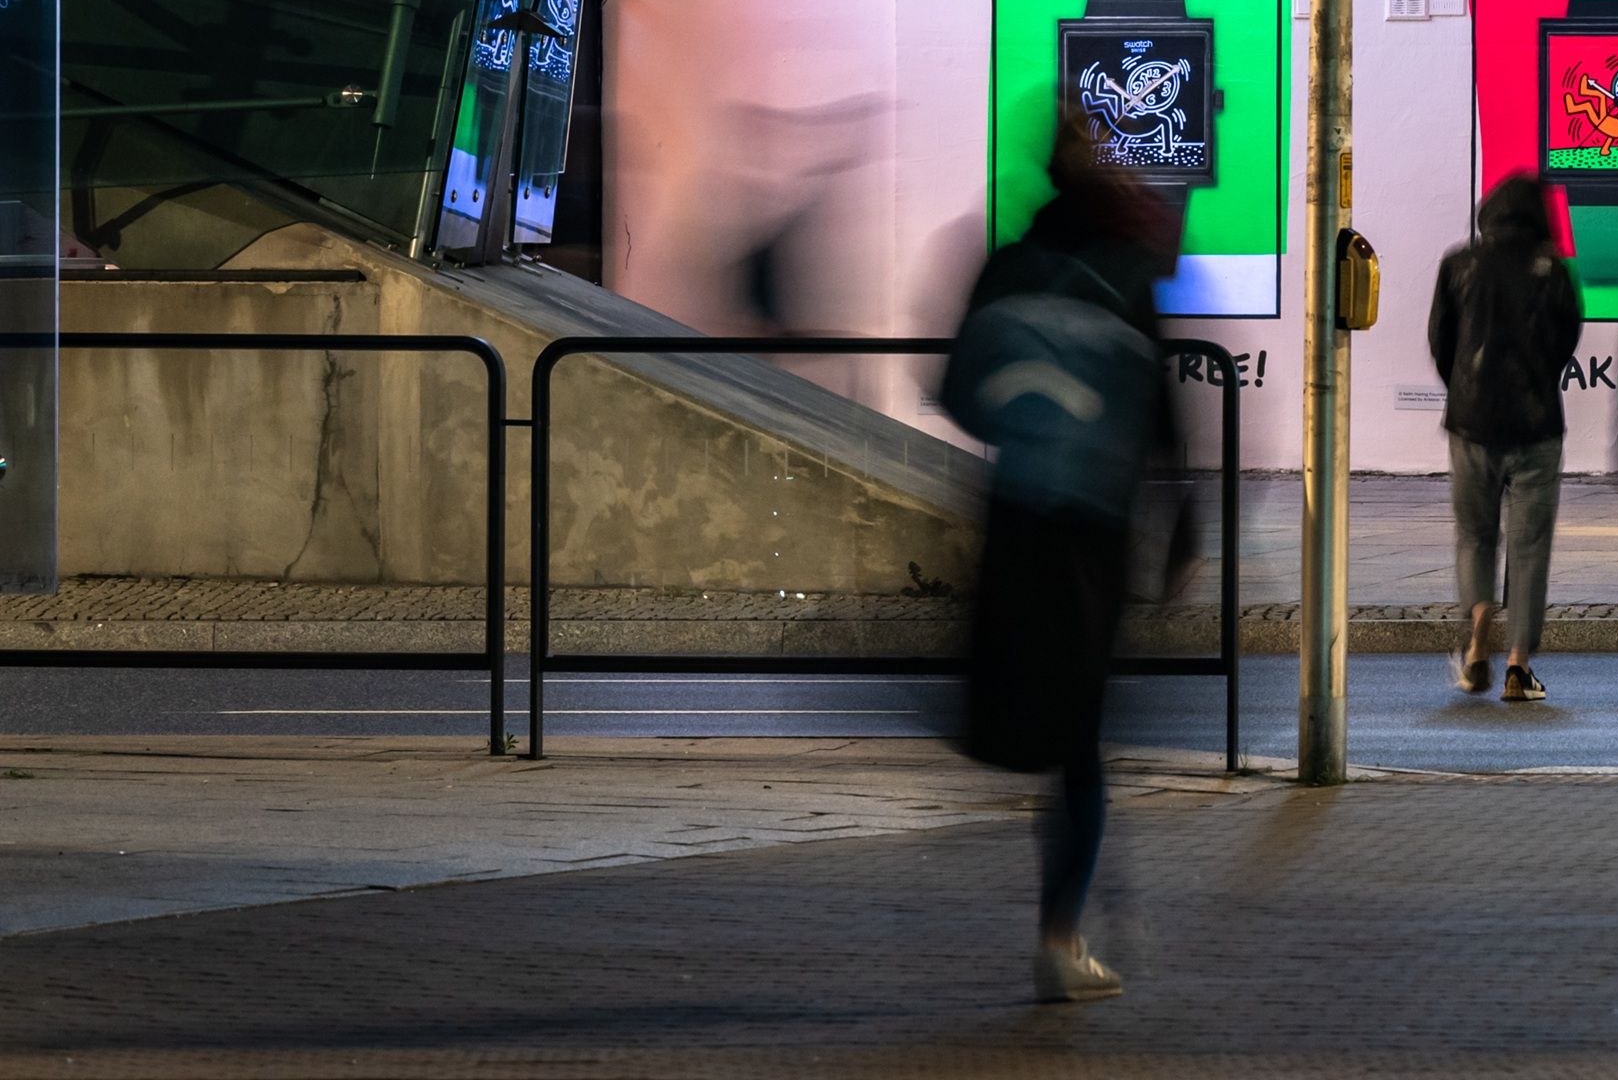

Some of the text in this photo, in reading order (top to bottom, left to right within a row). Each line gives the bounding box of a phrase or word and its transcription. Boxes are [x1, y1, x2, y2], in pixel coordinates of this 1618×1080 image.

[1123, 40, 1153, 48] swatch
[1161, 81, 1172, 97] 3
[1146, 94, 1156, 105] 6
